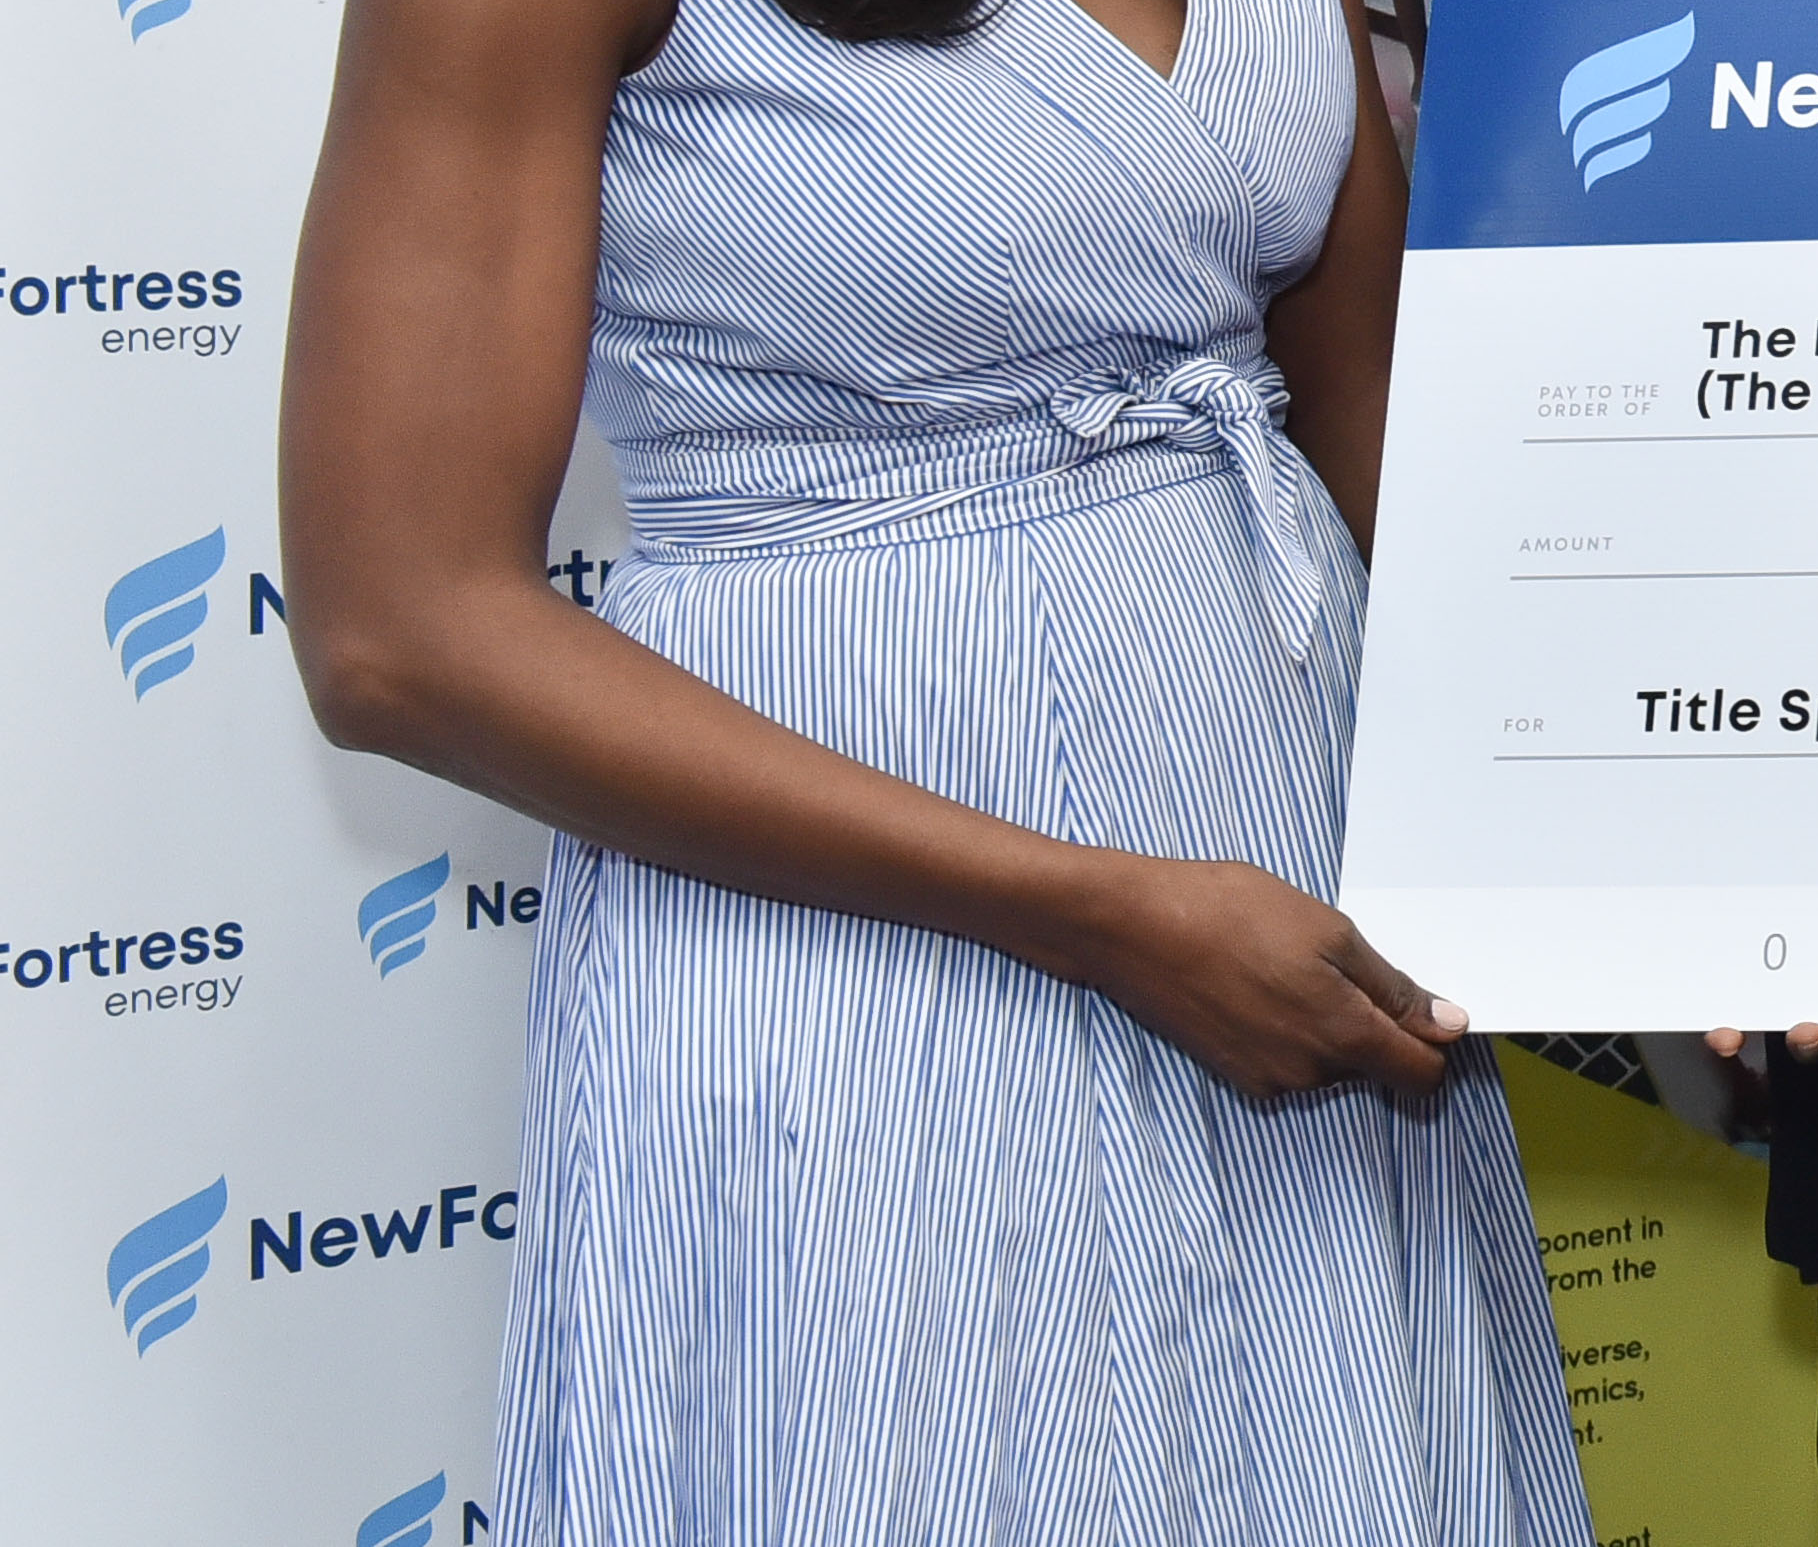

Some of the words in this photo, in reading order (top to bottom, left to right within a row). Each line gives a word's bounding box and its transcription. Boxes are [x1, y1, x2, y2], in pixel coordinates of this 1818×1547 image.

[101, 324, 242, 356] energy
[1702, 319, 1797, 359] The
[1539, 385, 1577, 400] PAY
[1587, 385, 1612, 399] TO
[1622, 384, 1660, 398] THE
[1697, 368, 1811, 419] (The
[1538, 403, 1608, 418] ORDER
[1624, 402, 1651, 416] OF
[1519, 536, 1614, 552] AMOUNT
[1637, 688, 1762, 733] Title
[1503, 718, 1546, 734] FOR
[104, 974, 243, 1017] energy
[1642, 1216, 1663, 1240] in
[1612, 1258, 1656, 1283] the
[1566, 1377, 1645, 1407] mics,
